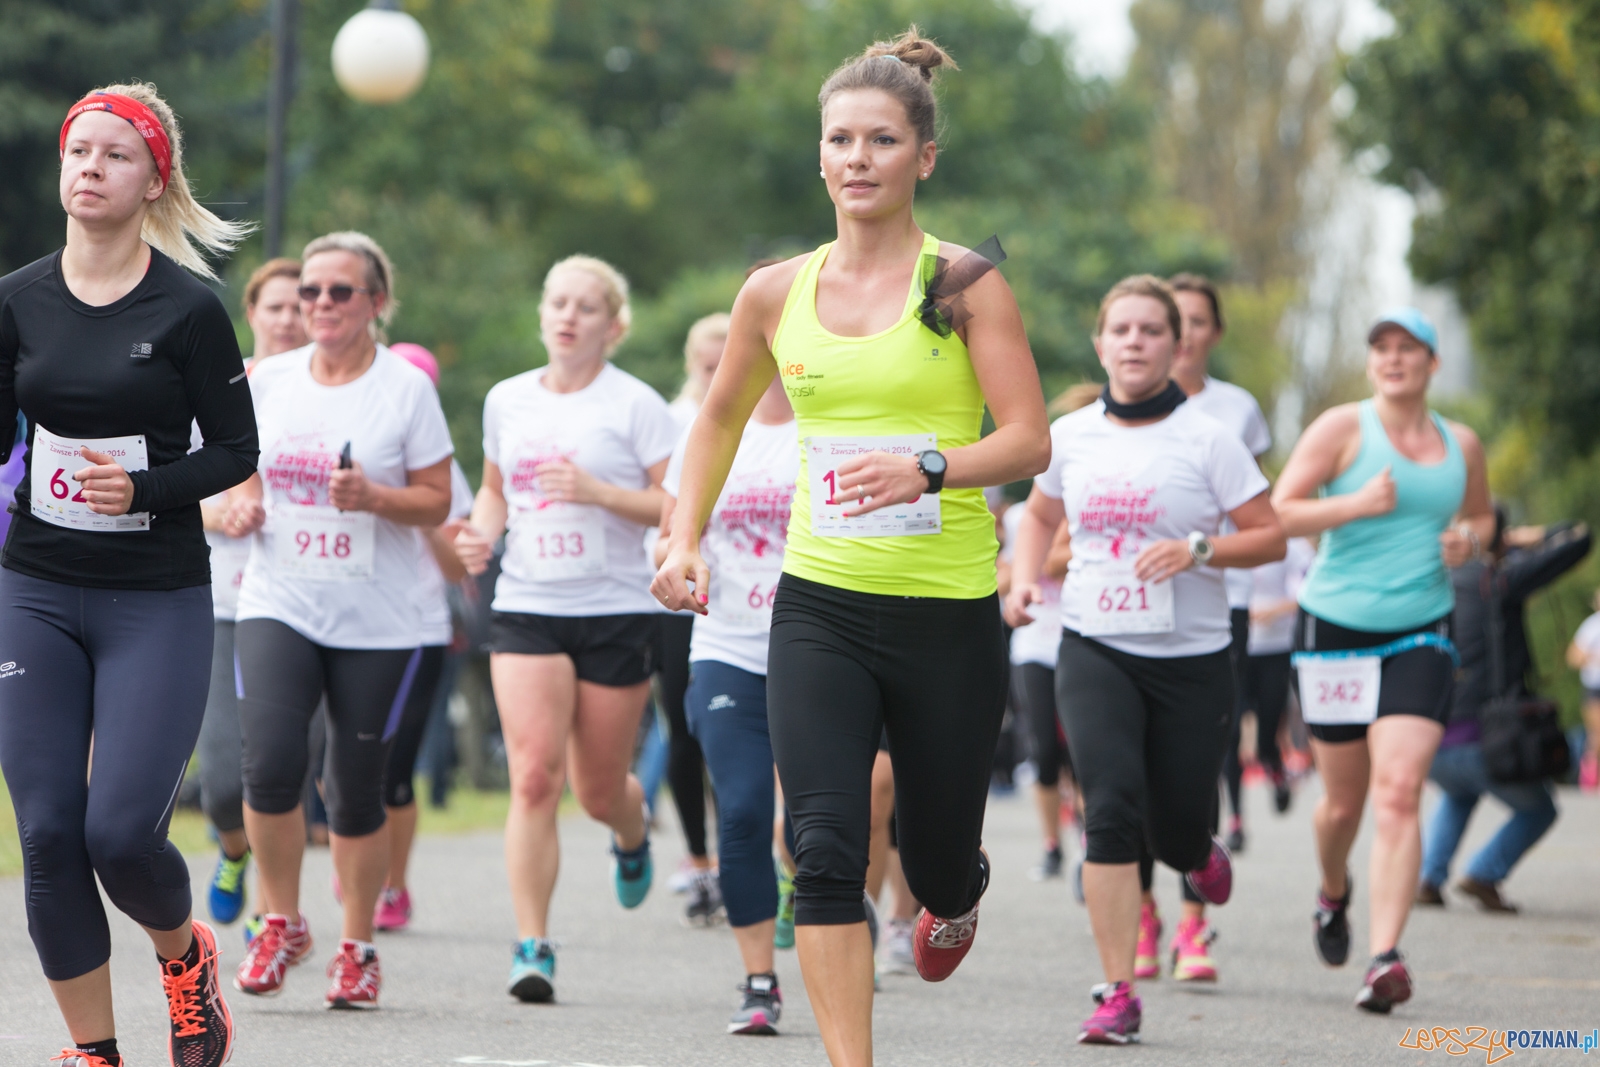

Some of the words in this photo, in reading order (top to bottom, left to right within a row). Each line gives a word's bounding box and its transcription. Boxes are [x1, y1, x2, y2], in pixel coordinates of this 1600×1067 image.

[830, 447, 856, 455] Zawsze
[892, 446, 912, 454] 2016
[295, 531, 352, 559] 918
[536, 531, 585, 559] 133
[1098, 585, 1151, 612] 621
[1317, 680, 1364, 705] 242
